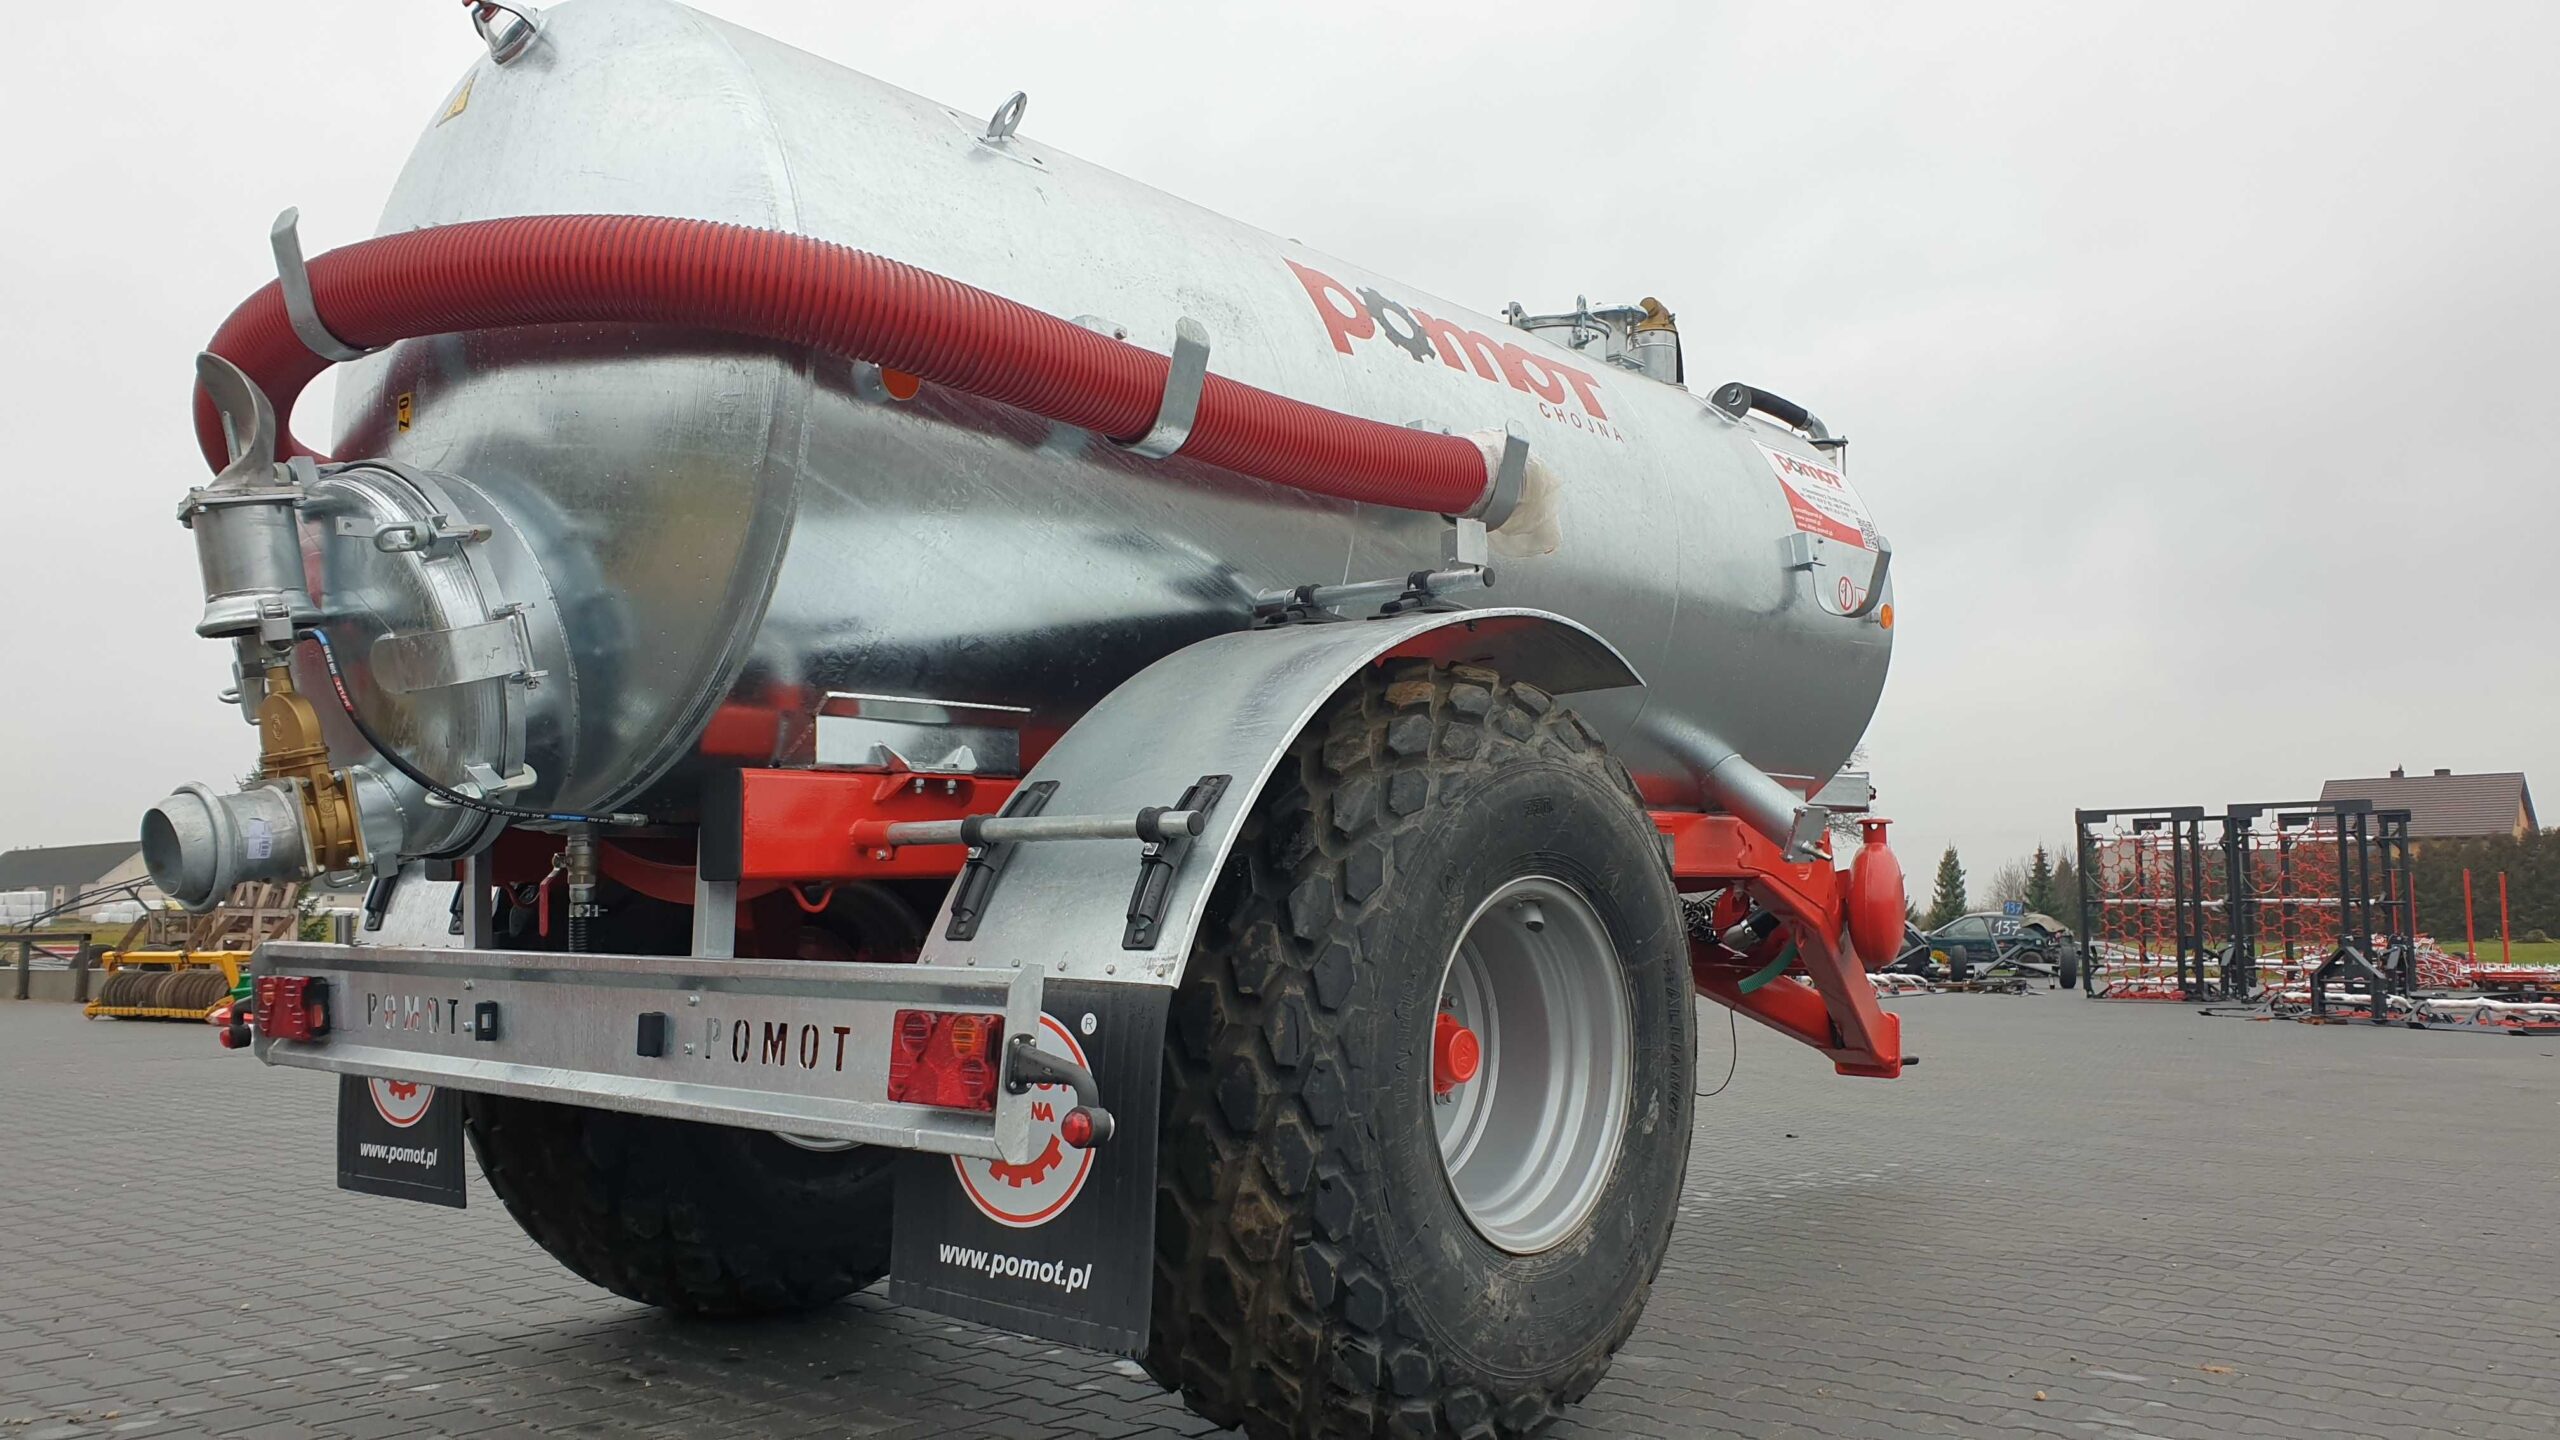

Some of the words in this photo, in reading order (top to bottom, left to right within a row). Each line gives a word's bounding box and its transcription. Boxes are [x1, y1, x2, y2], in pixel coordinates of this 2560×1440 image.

[1539, 402, 1625, 443] CHOJNA
[1993, 920, 2022, 936] 137
[2004, 901, 2023, 914] 137
[367, 993, 459, 1034] POMOT
[705, 1017, 851, 1072] POMOT
[360, 1142, 438, 1170] www.pomot.pl
[939, 1243, 1093, 1293] www.pomot.pl
